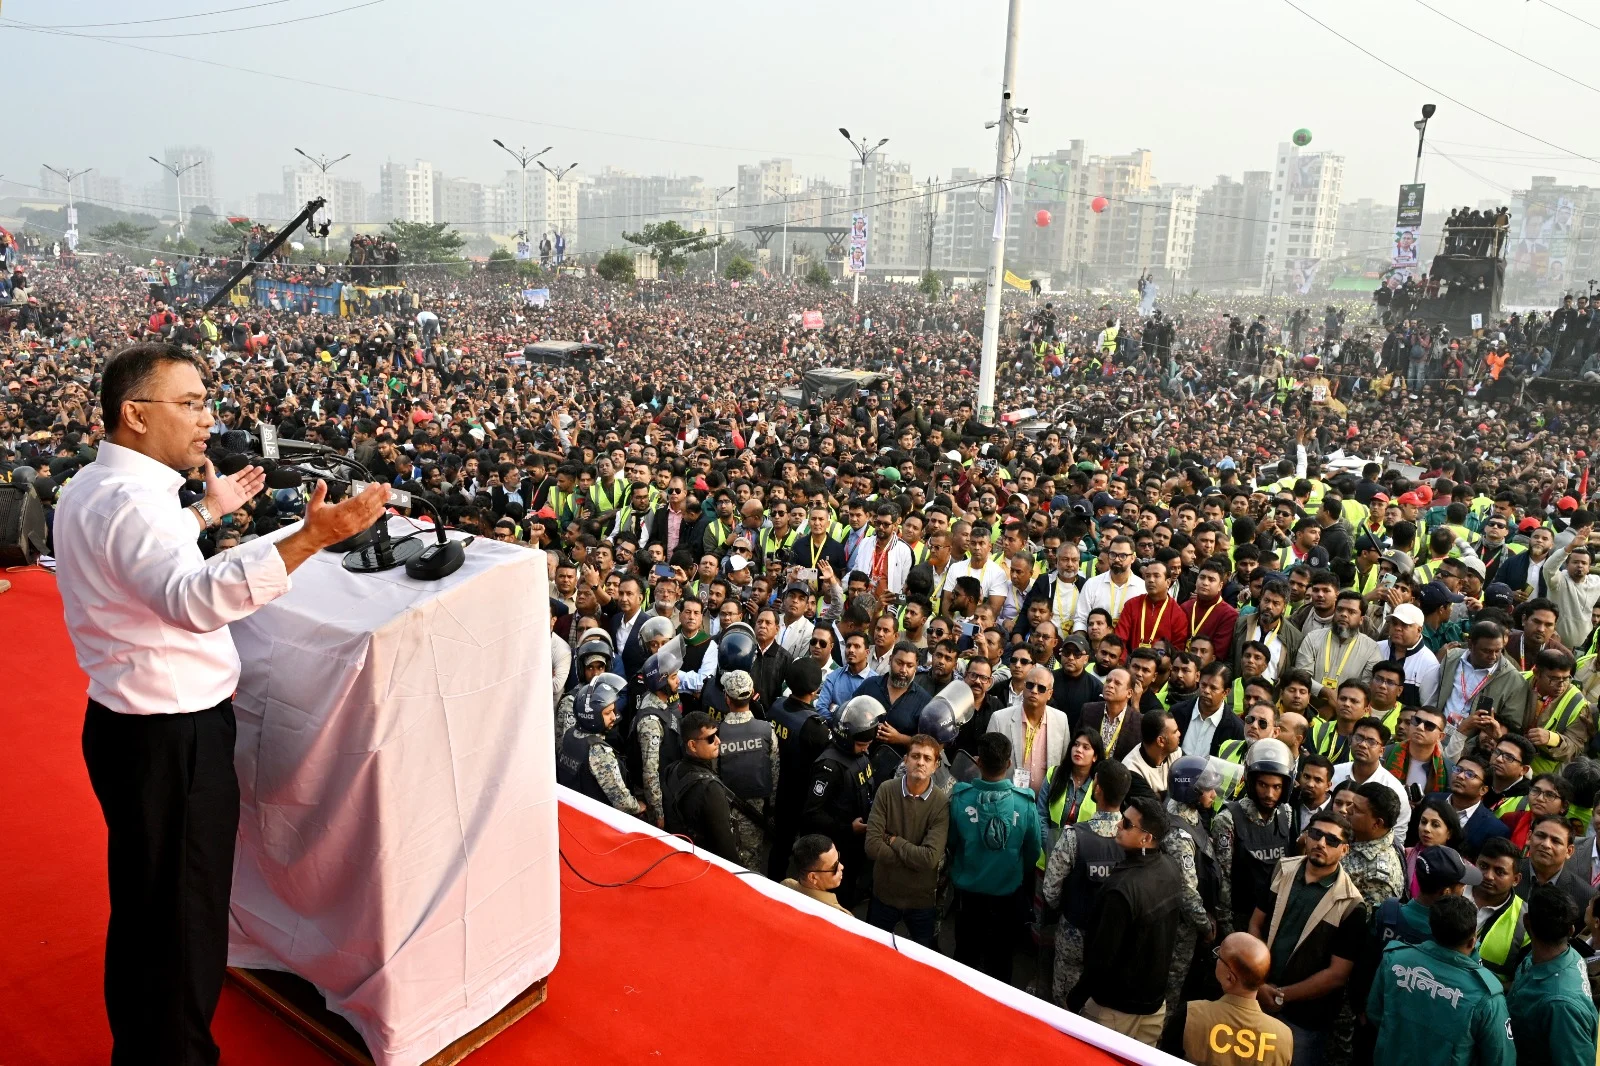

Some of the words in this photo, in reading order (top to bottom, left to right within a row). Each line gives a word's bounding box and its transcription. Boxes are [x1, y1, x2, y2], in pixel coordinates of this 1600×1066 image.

[646, 668, 658, 677] POLICE
[708, 706, 726, 721] RA
[720, 738, 762, 753] POLICE
[560, 754, 579, 770] POLICE
[1089, 865, 1111, 877] POL
[1391, 964, 1464, 1009] পুলিশ
[1209, 1023, 1277, 1062] CSF
